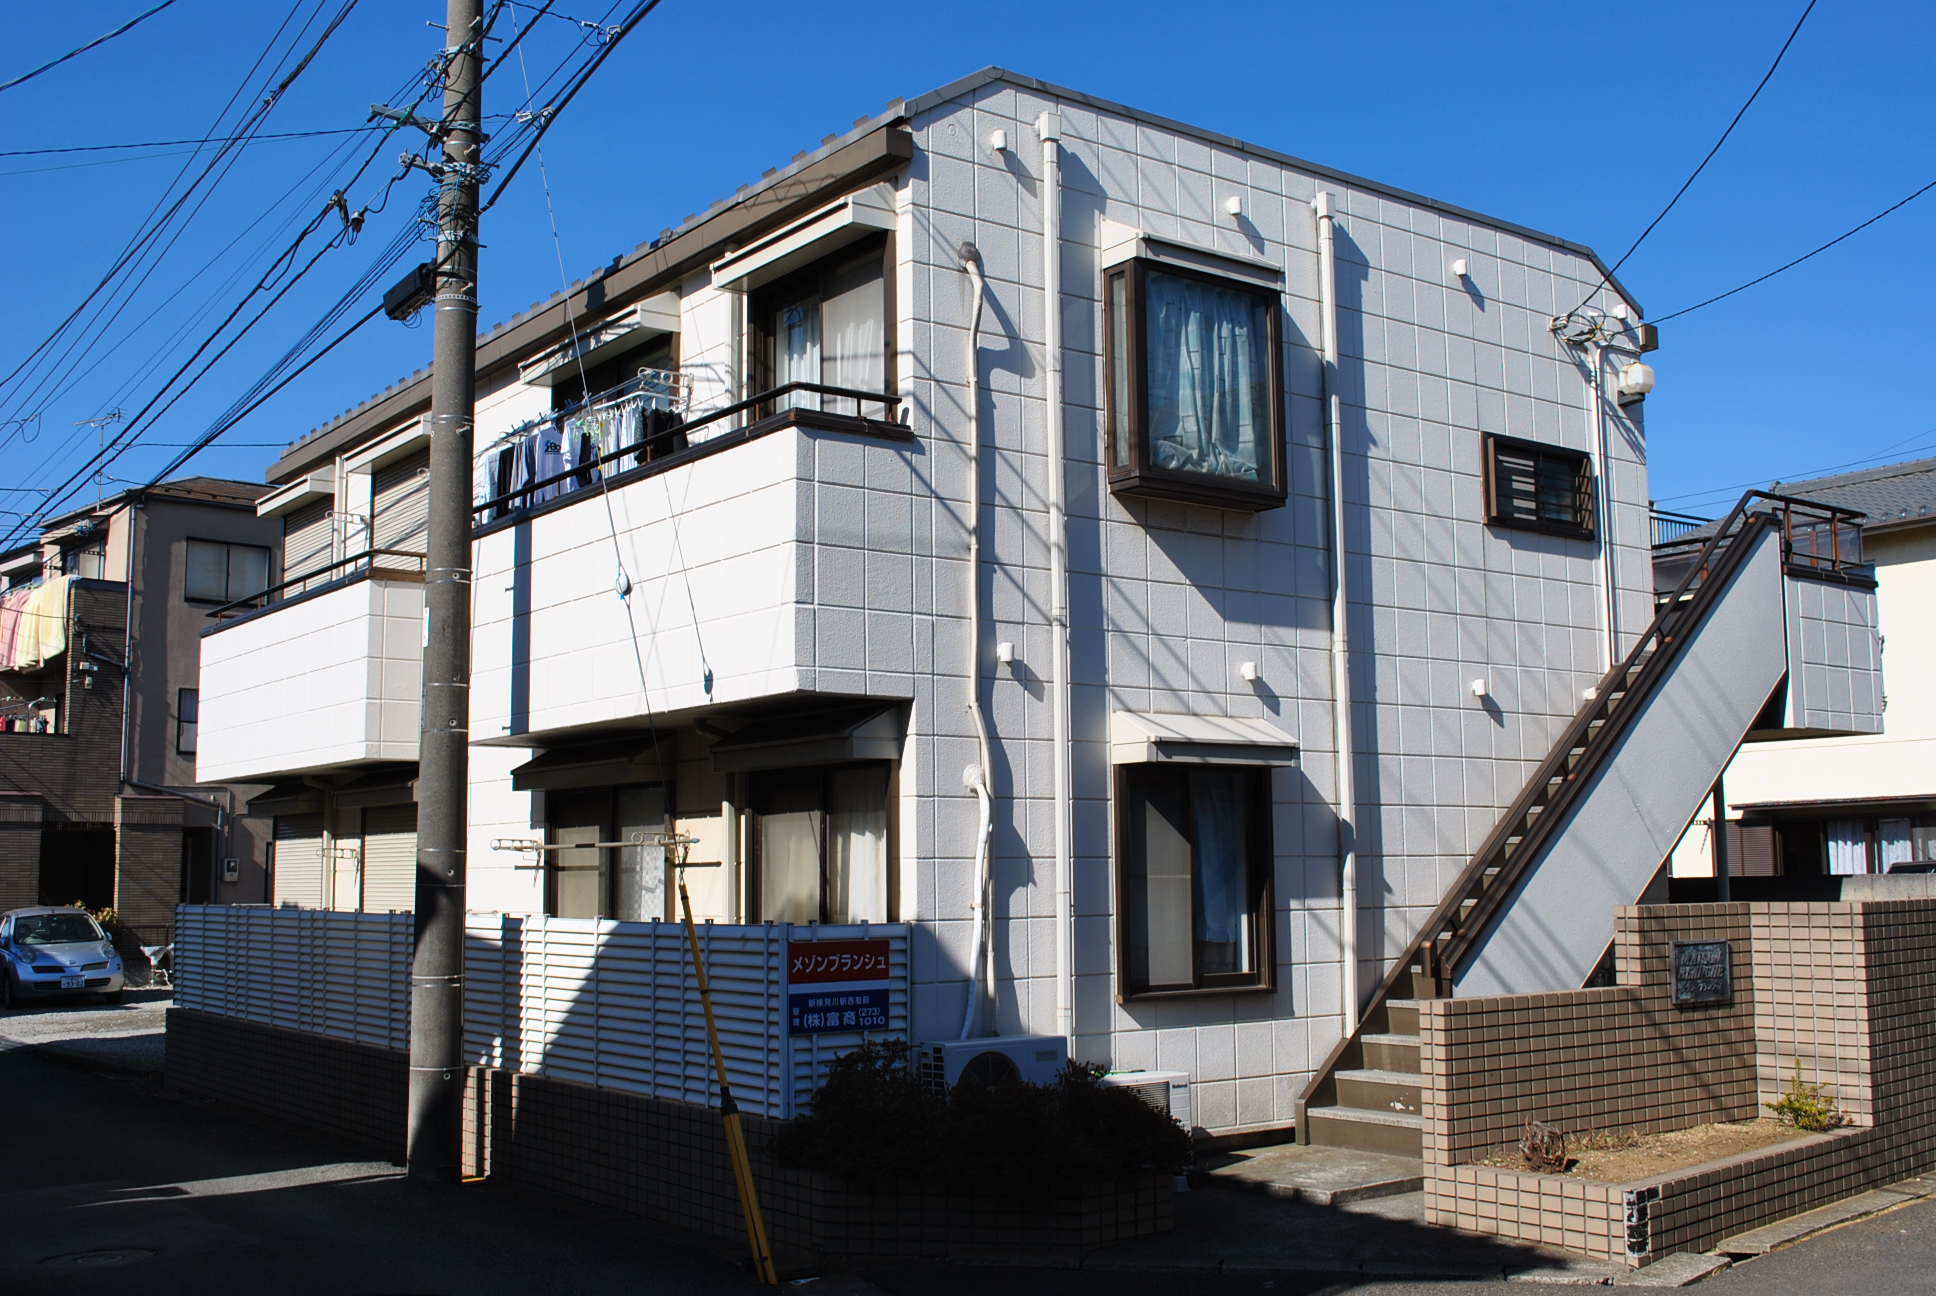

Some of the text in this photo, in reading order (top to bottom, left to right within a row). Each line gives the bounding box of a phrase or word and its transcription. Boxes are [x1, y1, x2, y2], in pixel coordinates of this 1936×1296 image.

[792, 953, 887, 974] メゾンブランシュ
[858, 1007, 881, 1017] (273)
[859, 1016, 886, 1026] 1010
